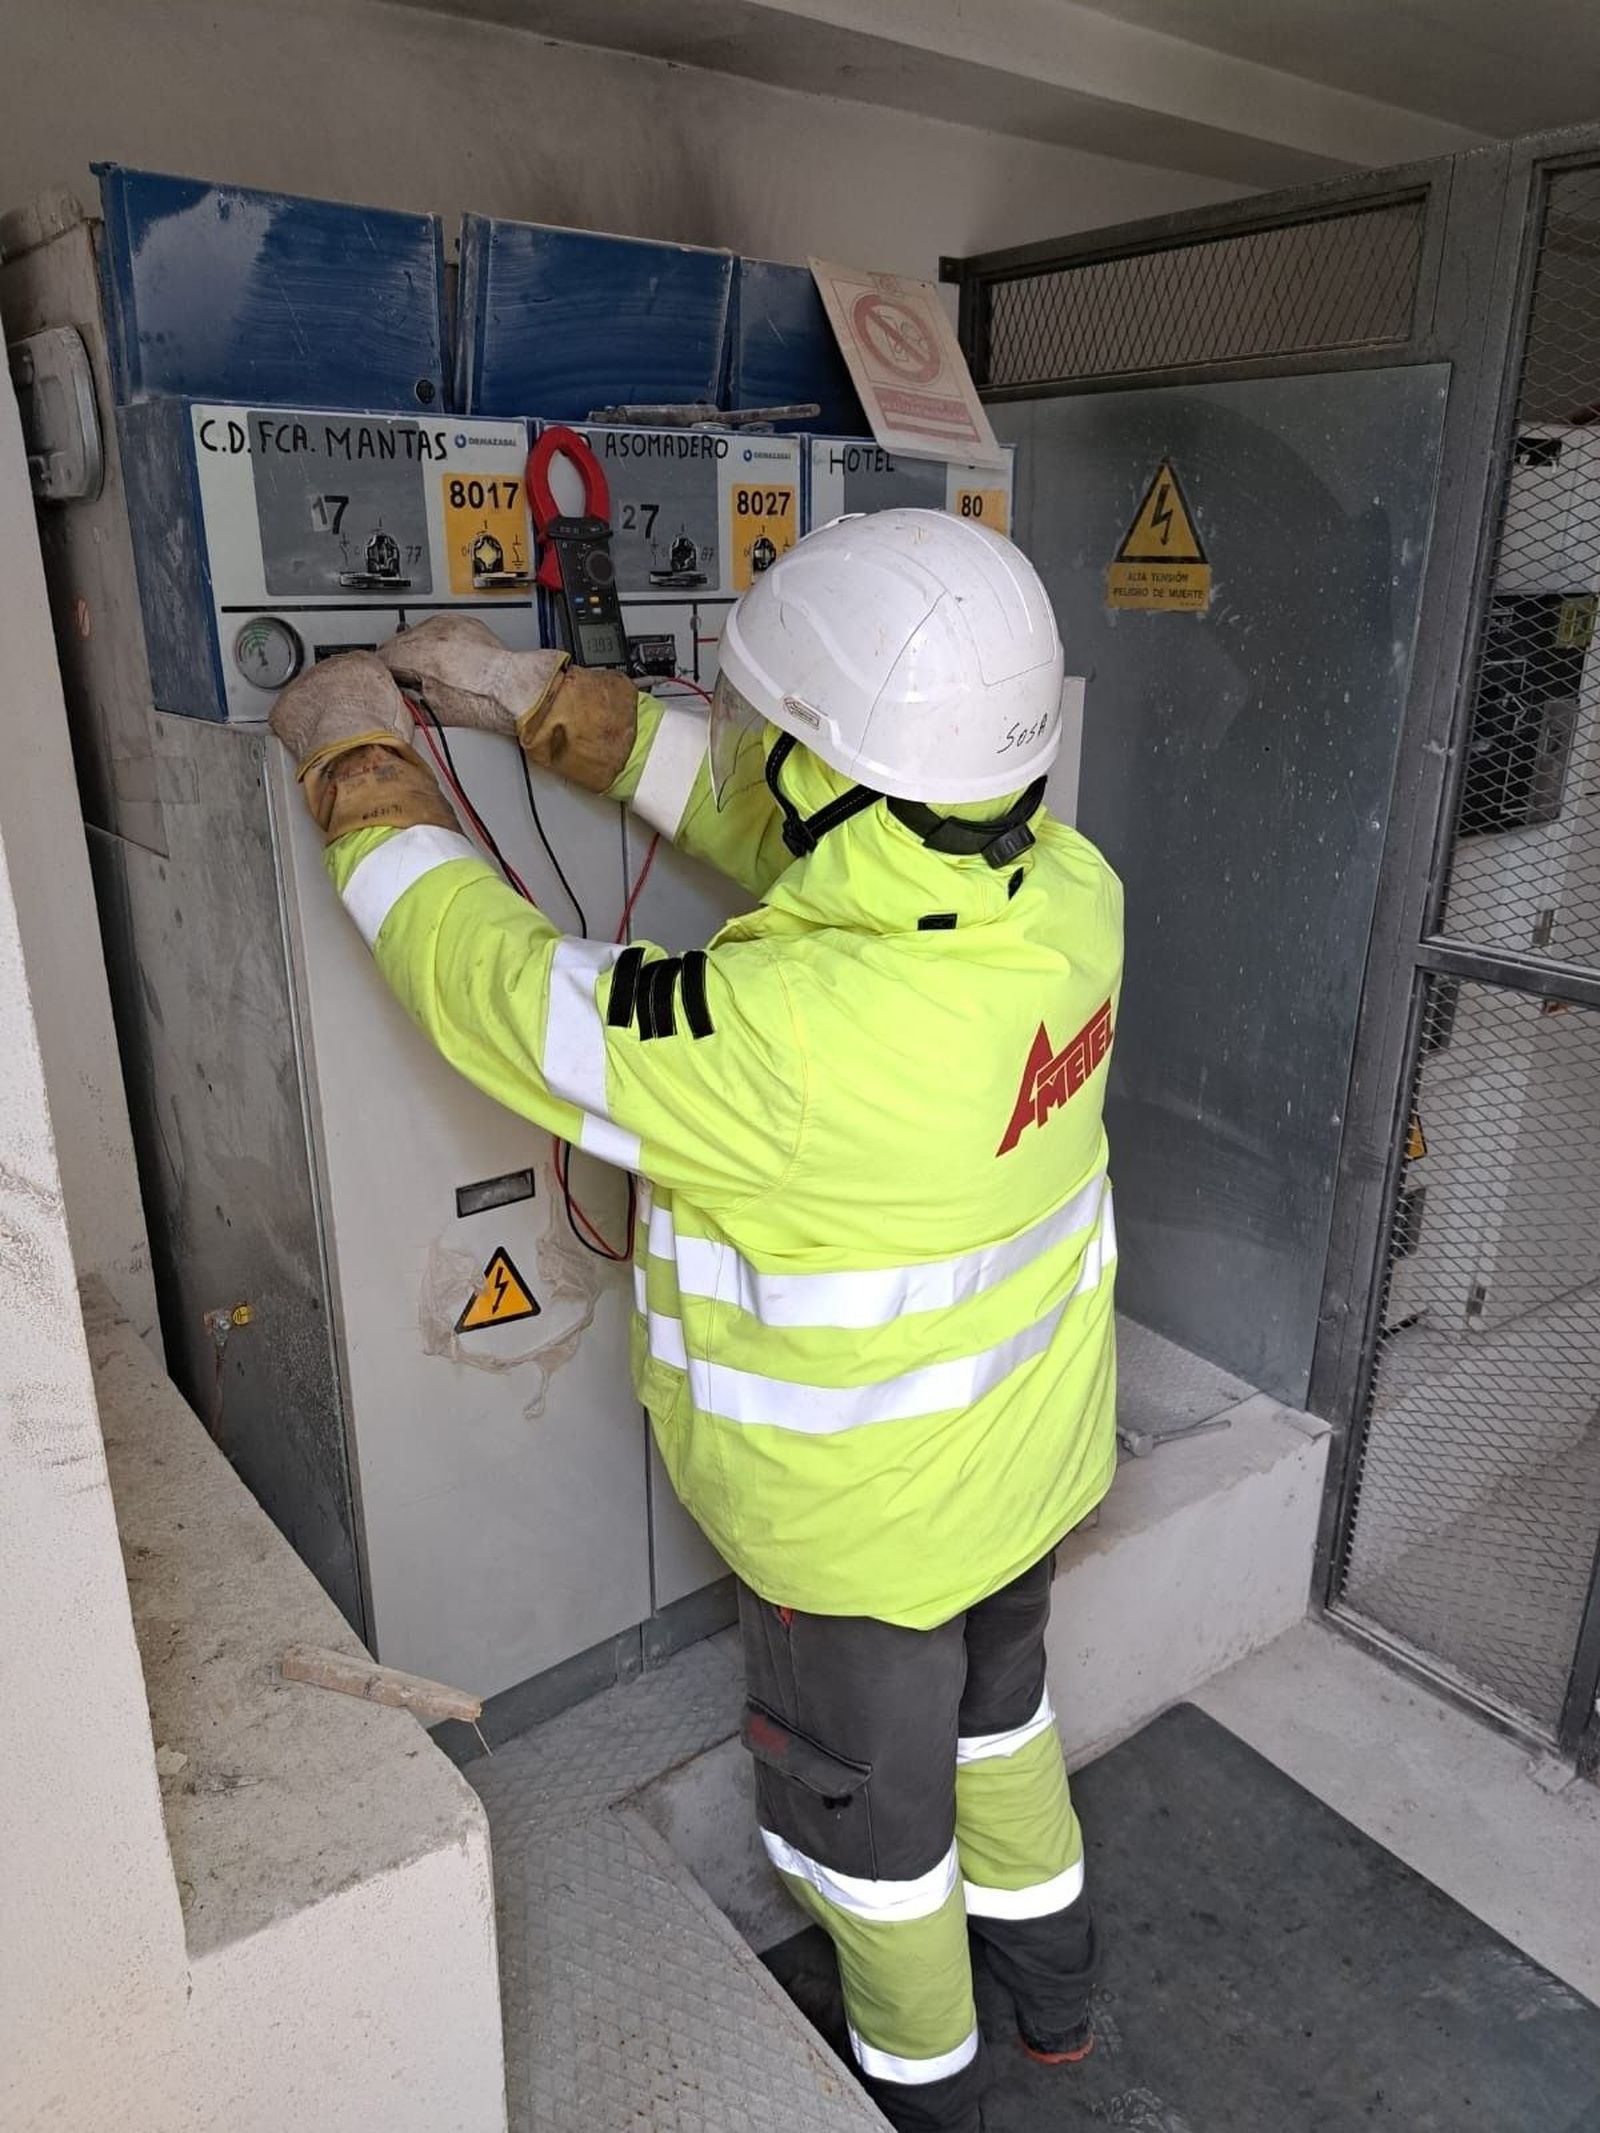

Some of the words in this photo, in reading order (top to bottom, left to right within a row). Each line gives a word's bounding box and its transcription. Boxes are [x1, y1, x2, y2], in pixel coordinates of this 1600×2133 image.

[200, 419, 251, 454] C.D.
[258, 421, 315, 453] FCA.
[325, 426, 447, 461] MANTAS
[605, 432, 729, 459] ASOMADERO
[829, 447, 895, 475] HOTEL
[450, 480, 519, 509] 8017
[737, 490, 791, 516] 8027
[961, 495, 983, 517] 80
[312, 495, 349, 535] 17
[622, 504, 660, 539] 27
[1128, 571, 1147, 581] ALTA
[1113, 587, 1149, 598] PELIGRO
[1153, 588, 1164, 598] DE
[1169, 589, 1206, 599] MUERTE
[995, 996, 1114, 1158] AMETEL
